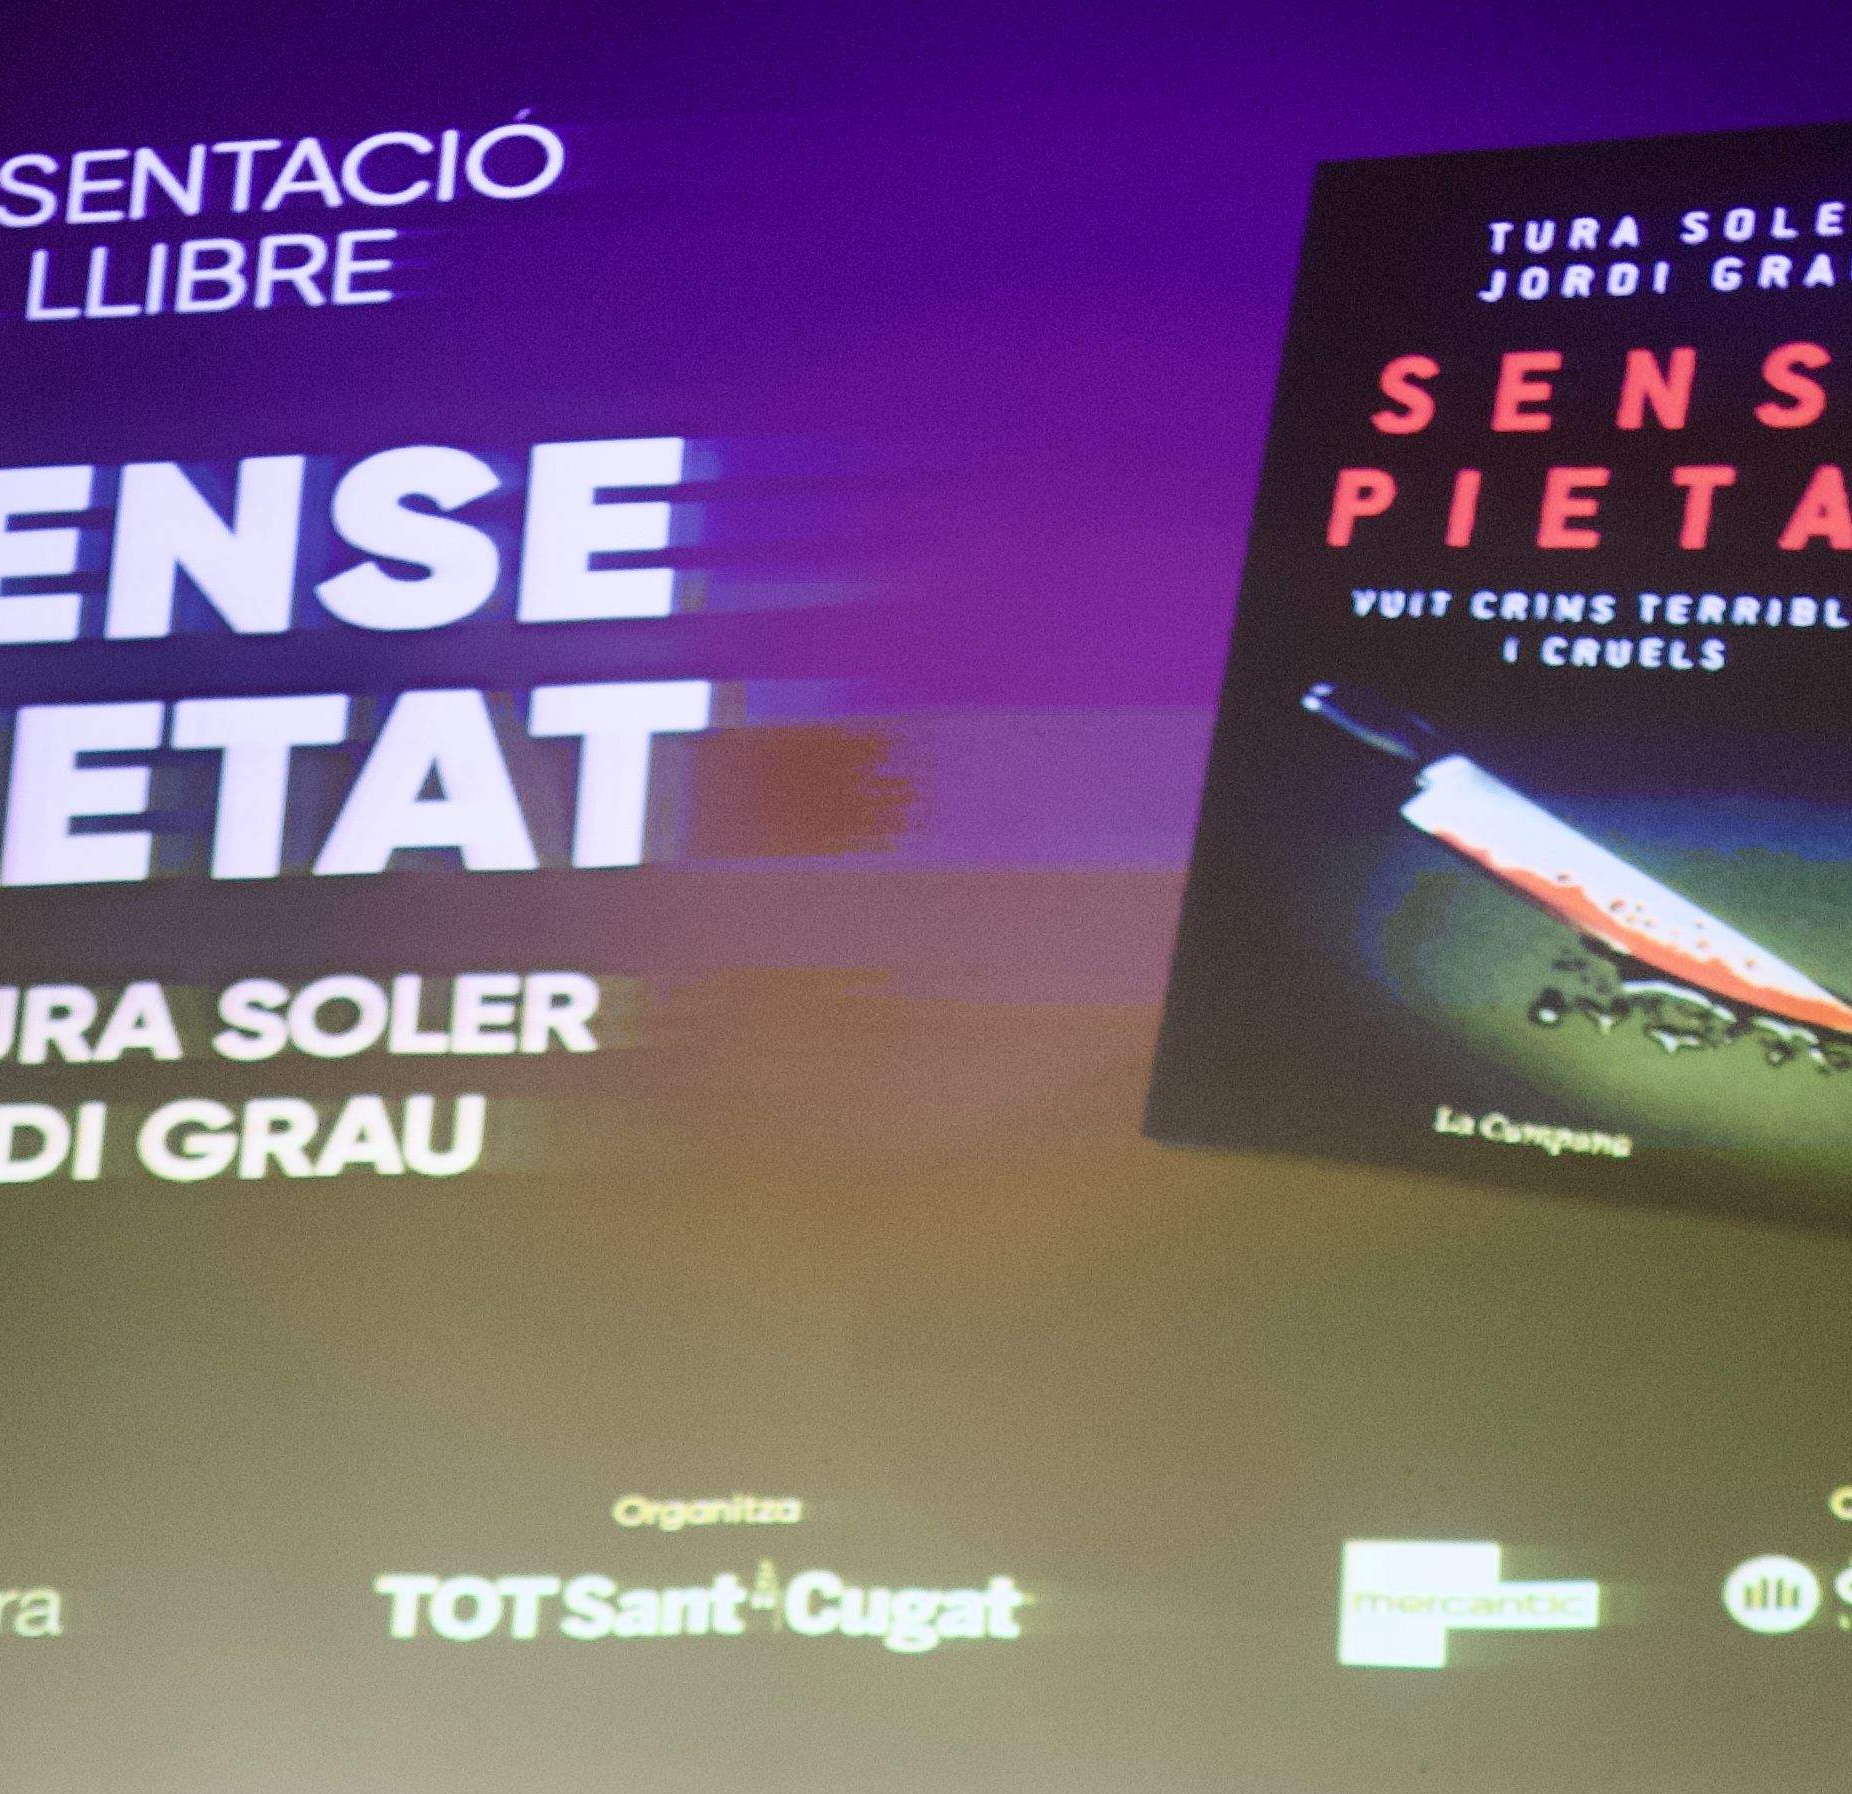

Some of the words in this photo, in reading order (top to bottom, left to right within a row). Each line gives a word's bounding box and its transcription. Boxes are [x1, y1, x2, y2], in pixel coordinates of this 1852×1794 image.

[1488, 214, 1642, 255] TURA
[24, 229, 399, 320] LLIBRE
[1477, 258, 1672, 303] JORDI
[1350, 588, 1454, 619] VUIT
[1540, 636, 1727, 671] CRUELS
[212, 972, 602, 1060] SOLER
[136, 1094, 488, 1181] GRAU
[613, 1495, 801, 1530] Organitza
[785, 1570, 1024, 1653] Cugat
